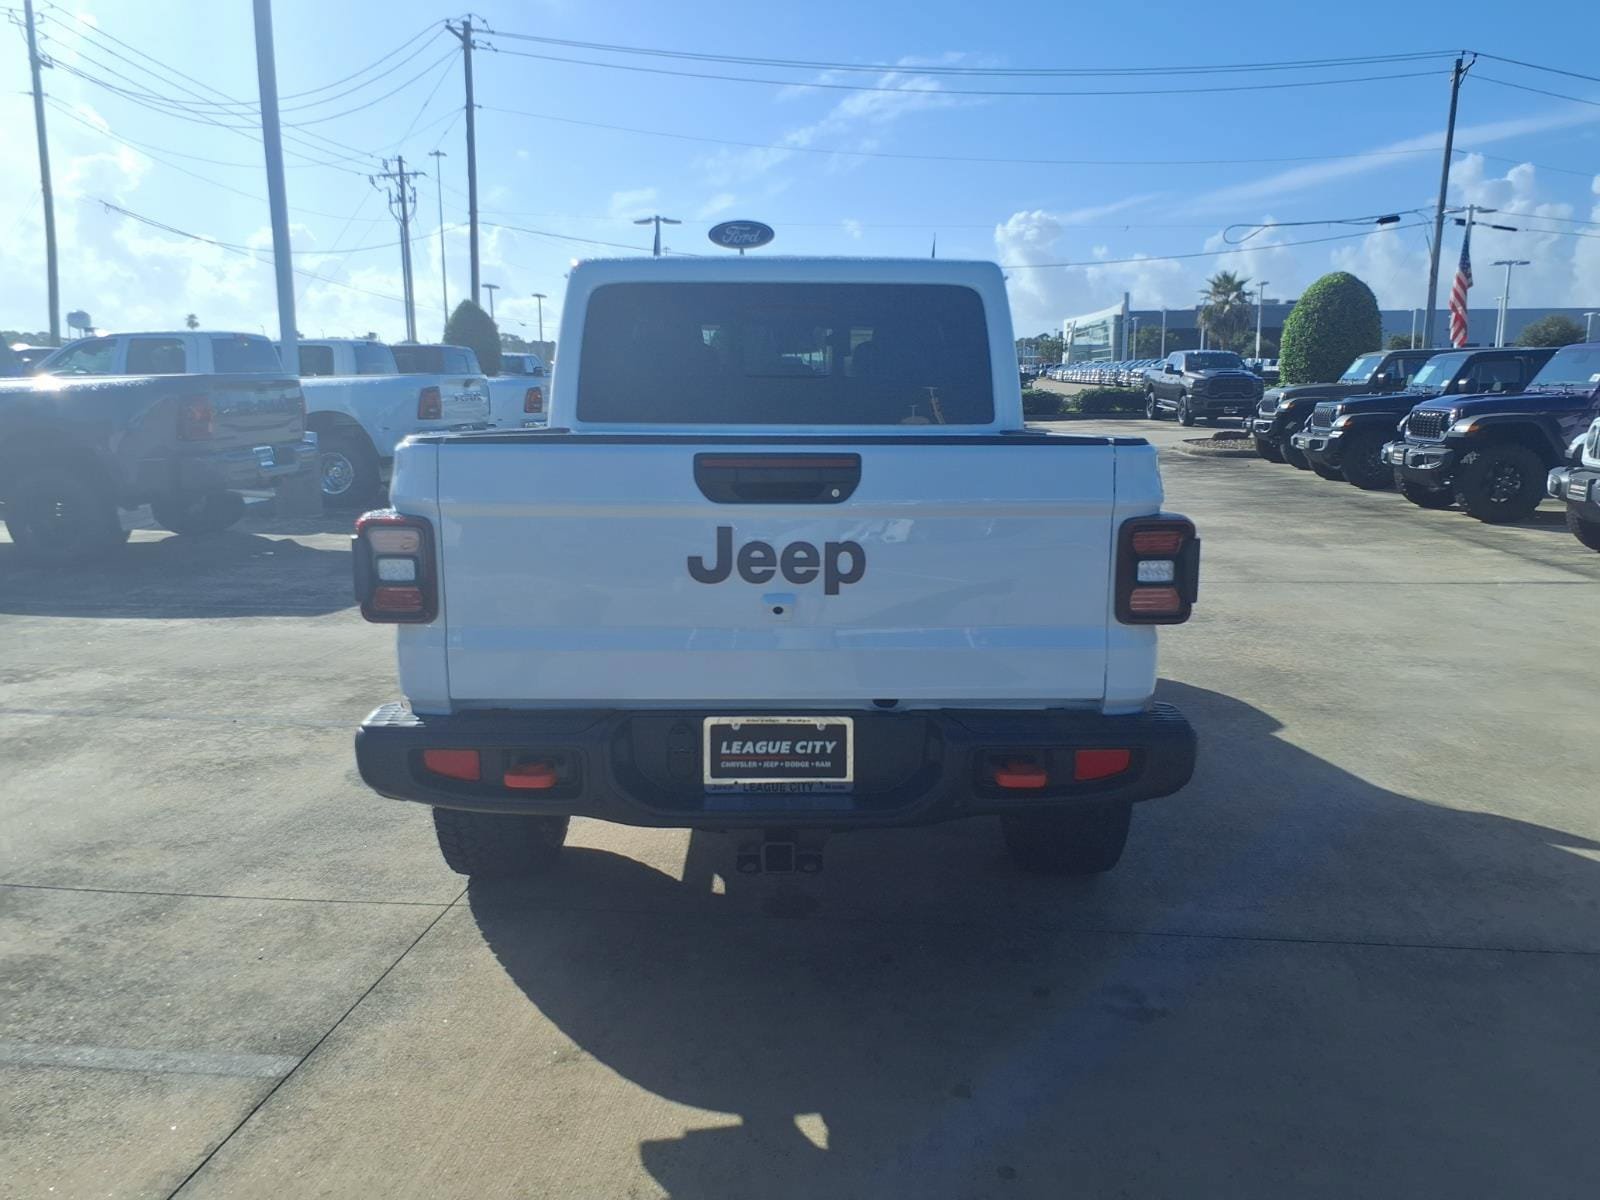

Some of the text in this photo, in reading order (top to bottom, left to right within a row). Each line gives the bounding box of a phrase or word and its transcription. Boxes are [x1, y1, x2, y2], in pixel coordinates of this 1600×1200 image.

[722, 226, 761, 243] Ford
[687, 526, 866, 595] Jeep
[720, 740, 837, 754] LEAGUE CITY
[720, 760, 831, 768] CHRYSLER JEEP DODGE RAM
[790, 782, 815, 792] CITY
